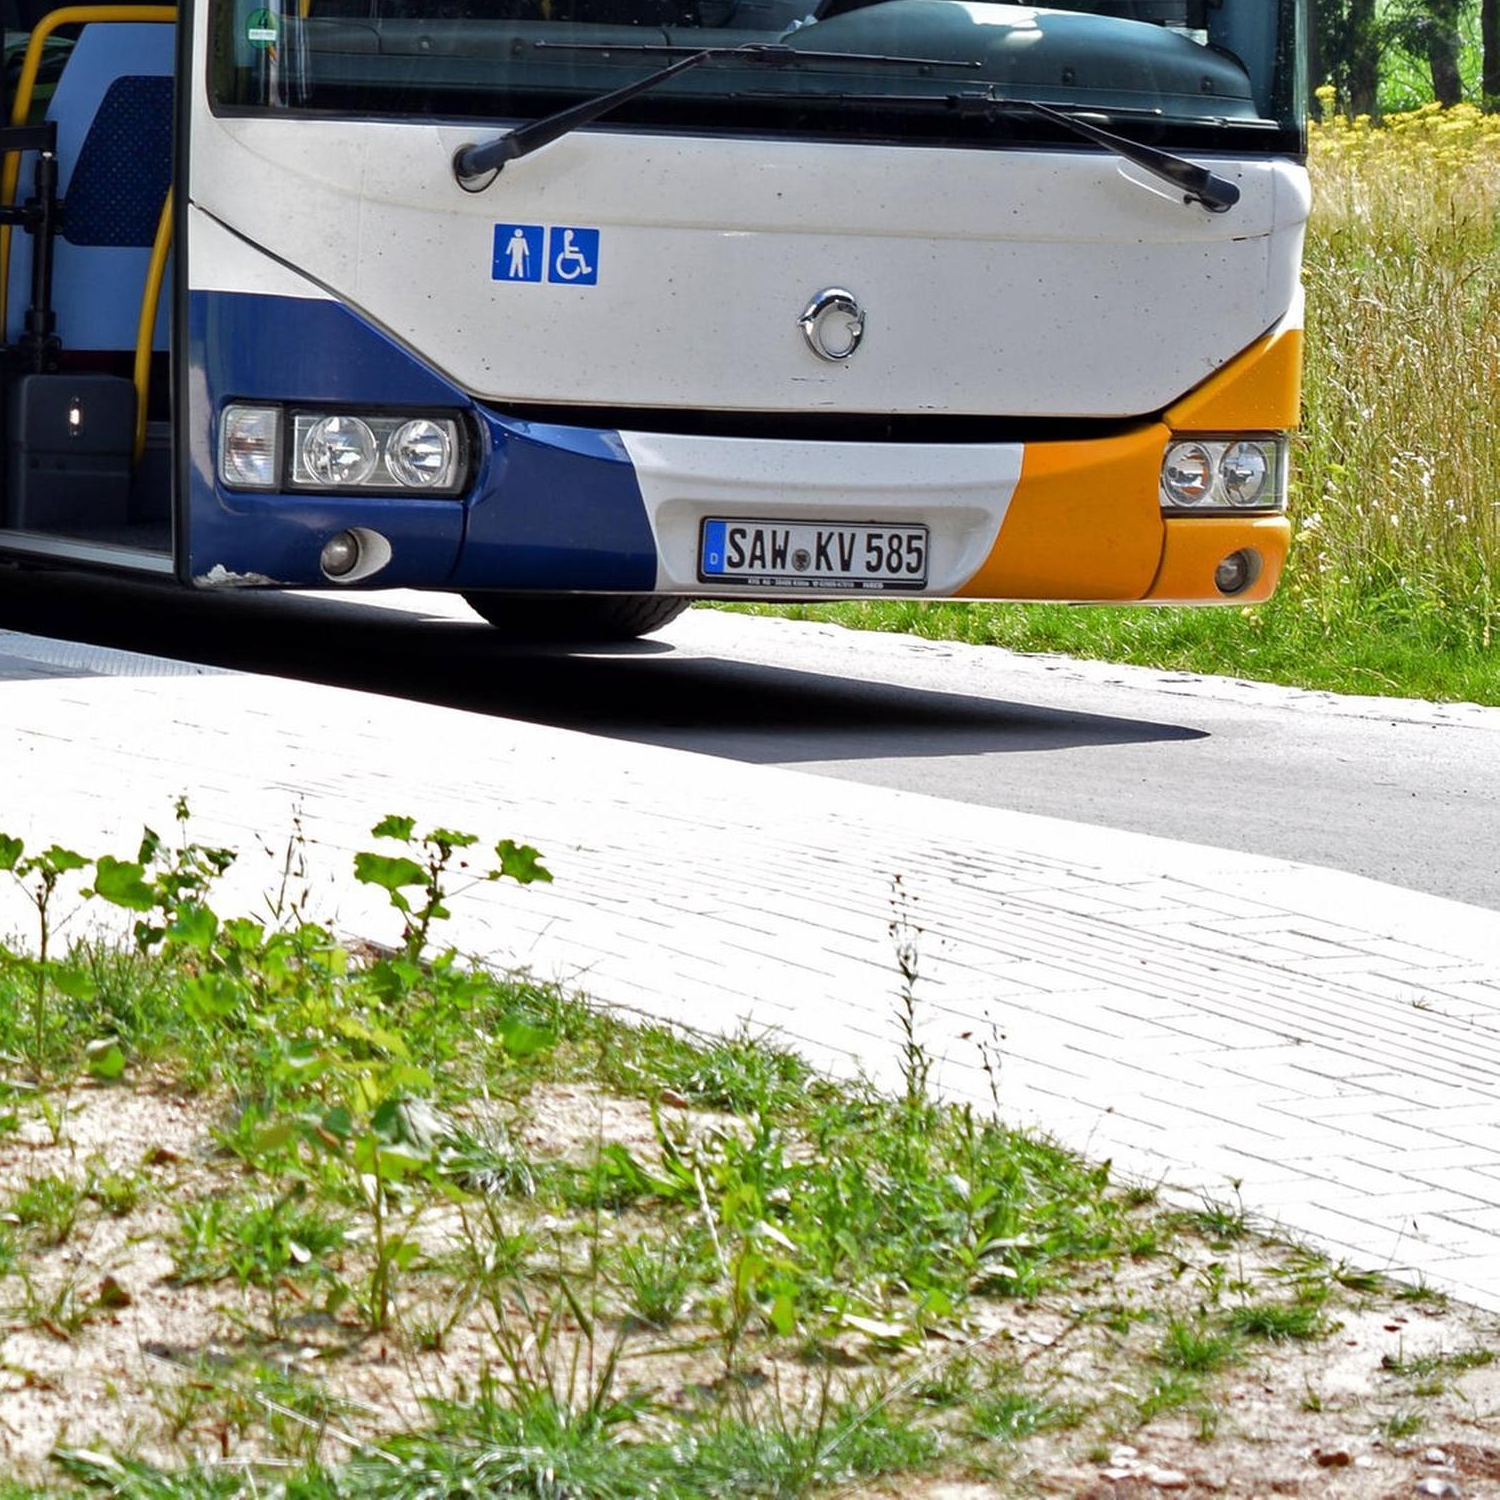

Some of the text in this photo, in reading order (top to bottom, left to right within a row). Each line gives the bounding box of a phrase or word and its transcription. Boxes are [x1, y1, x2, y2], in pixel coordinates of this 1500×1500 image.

[726, 527, 791, 570] SAW
[814, 531, 857, 573] KV
[864, 533, 924, 574] 585
